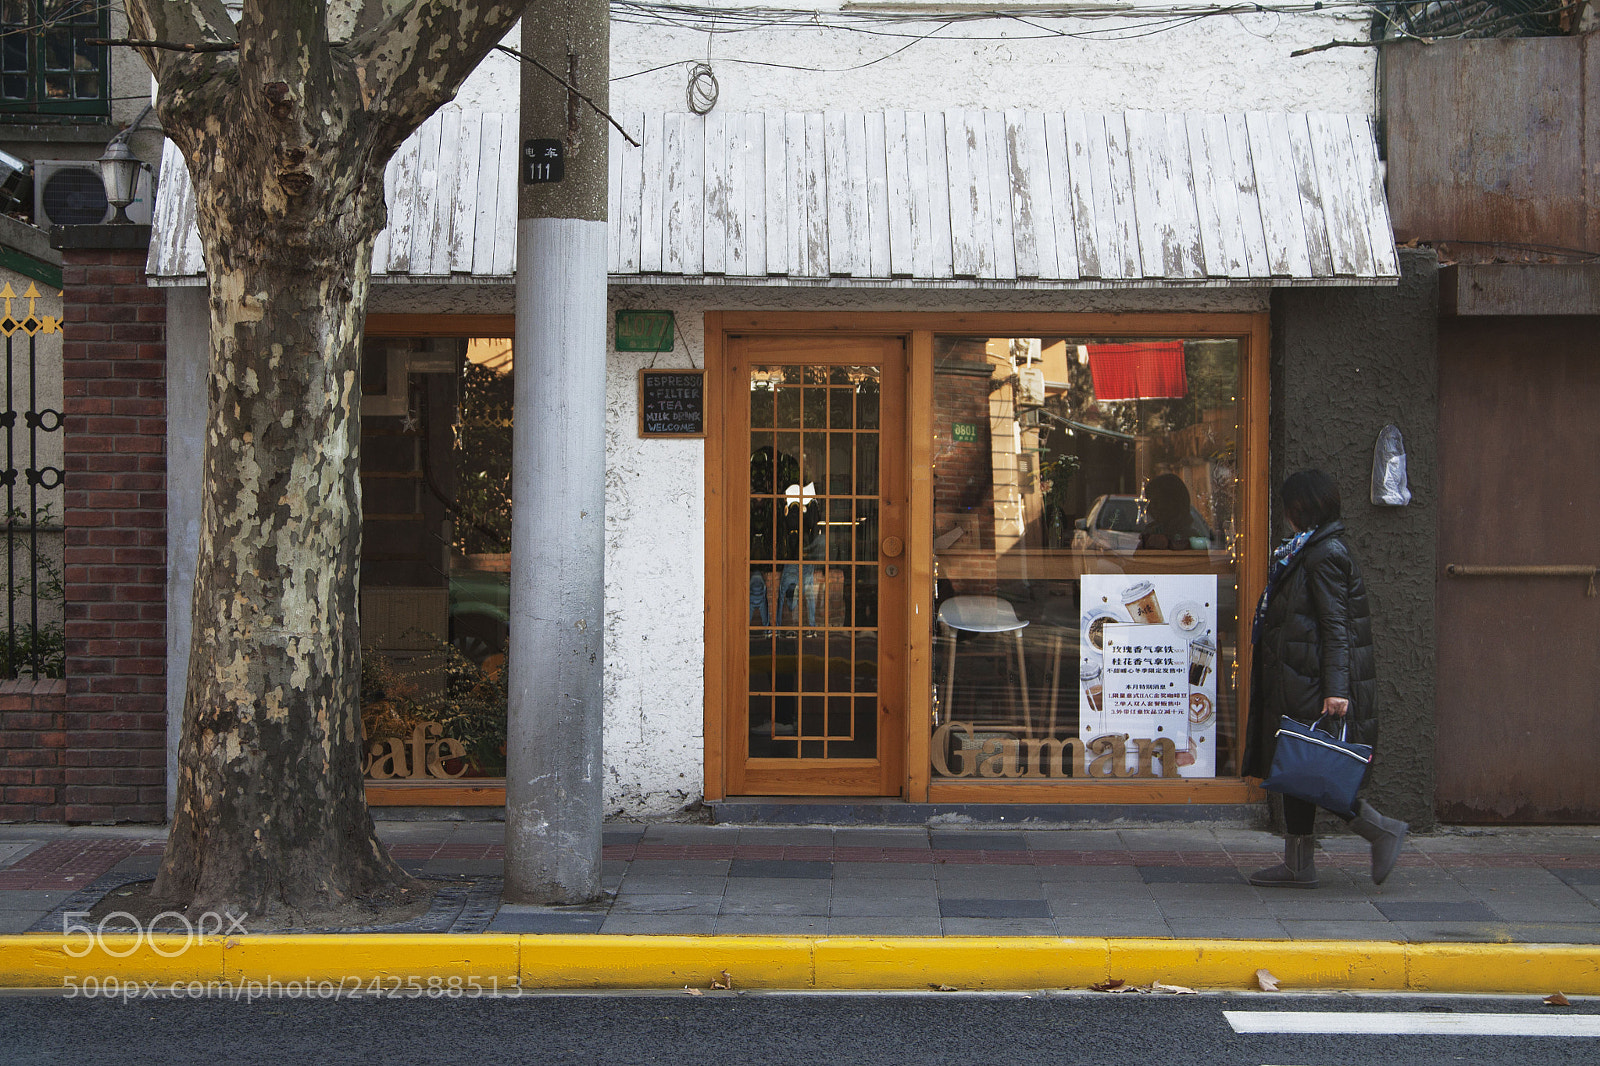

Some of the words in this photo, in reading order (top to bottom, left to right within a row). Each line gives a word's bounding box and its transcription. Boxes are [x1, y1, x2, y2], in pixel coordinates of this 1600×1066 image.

[525, 147, 558, 159] 电车
[530, 163, 551, 180] 111
[622, 315, 668, 337] 1077
[646, 376, 702, 387] ESPRESSO
[656, 388, 699, 399] FILTER
[657, 400, 683, 410] TEA
[646, 412, 669, 421] MILK
[673, 411, 700, 421] DRINK
[648, 423, 696, 432] WELCOME
[1112, 645, 1174, 654] 玫瑰香气拿铁
[1112, 658, 1174, 666] 桂花香气拿铁
[361, 719, 469, 779] afe
[930, 720, 1182, 779] Gaman
